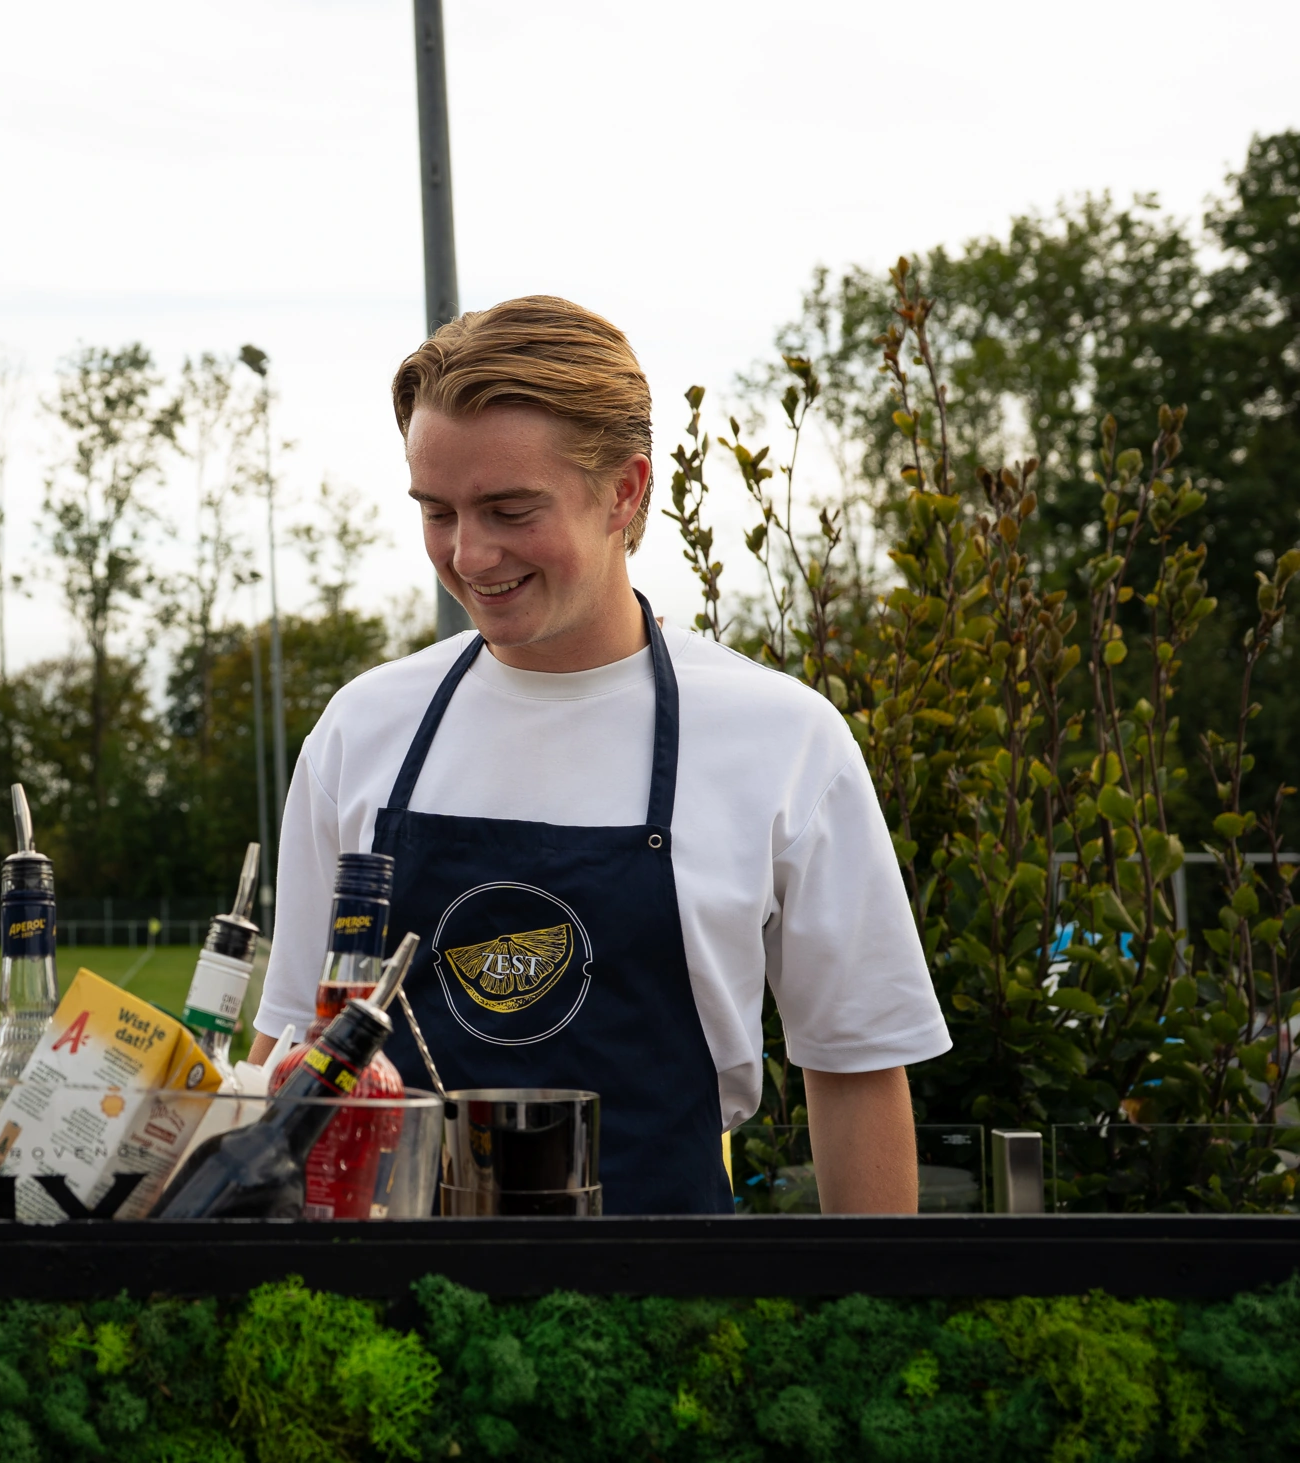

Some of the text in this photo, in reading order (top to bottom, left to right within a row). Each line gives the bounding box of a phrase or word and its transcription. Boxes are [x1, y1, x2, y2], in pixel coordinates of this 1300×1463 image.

[9, 918, 45, 936] APEROL
[481, 952, 542, 979] ZEST
[118, 1007, 167, 1042] Wist je
